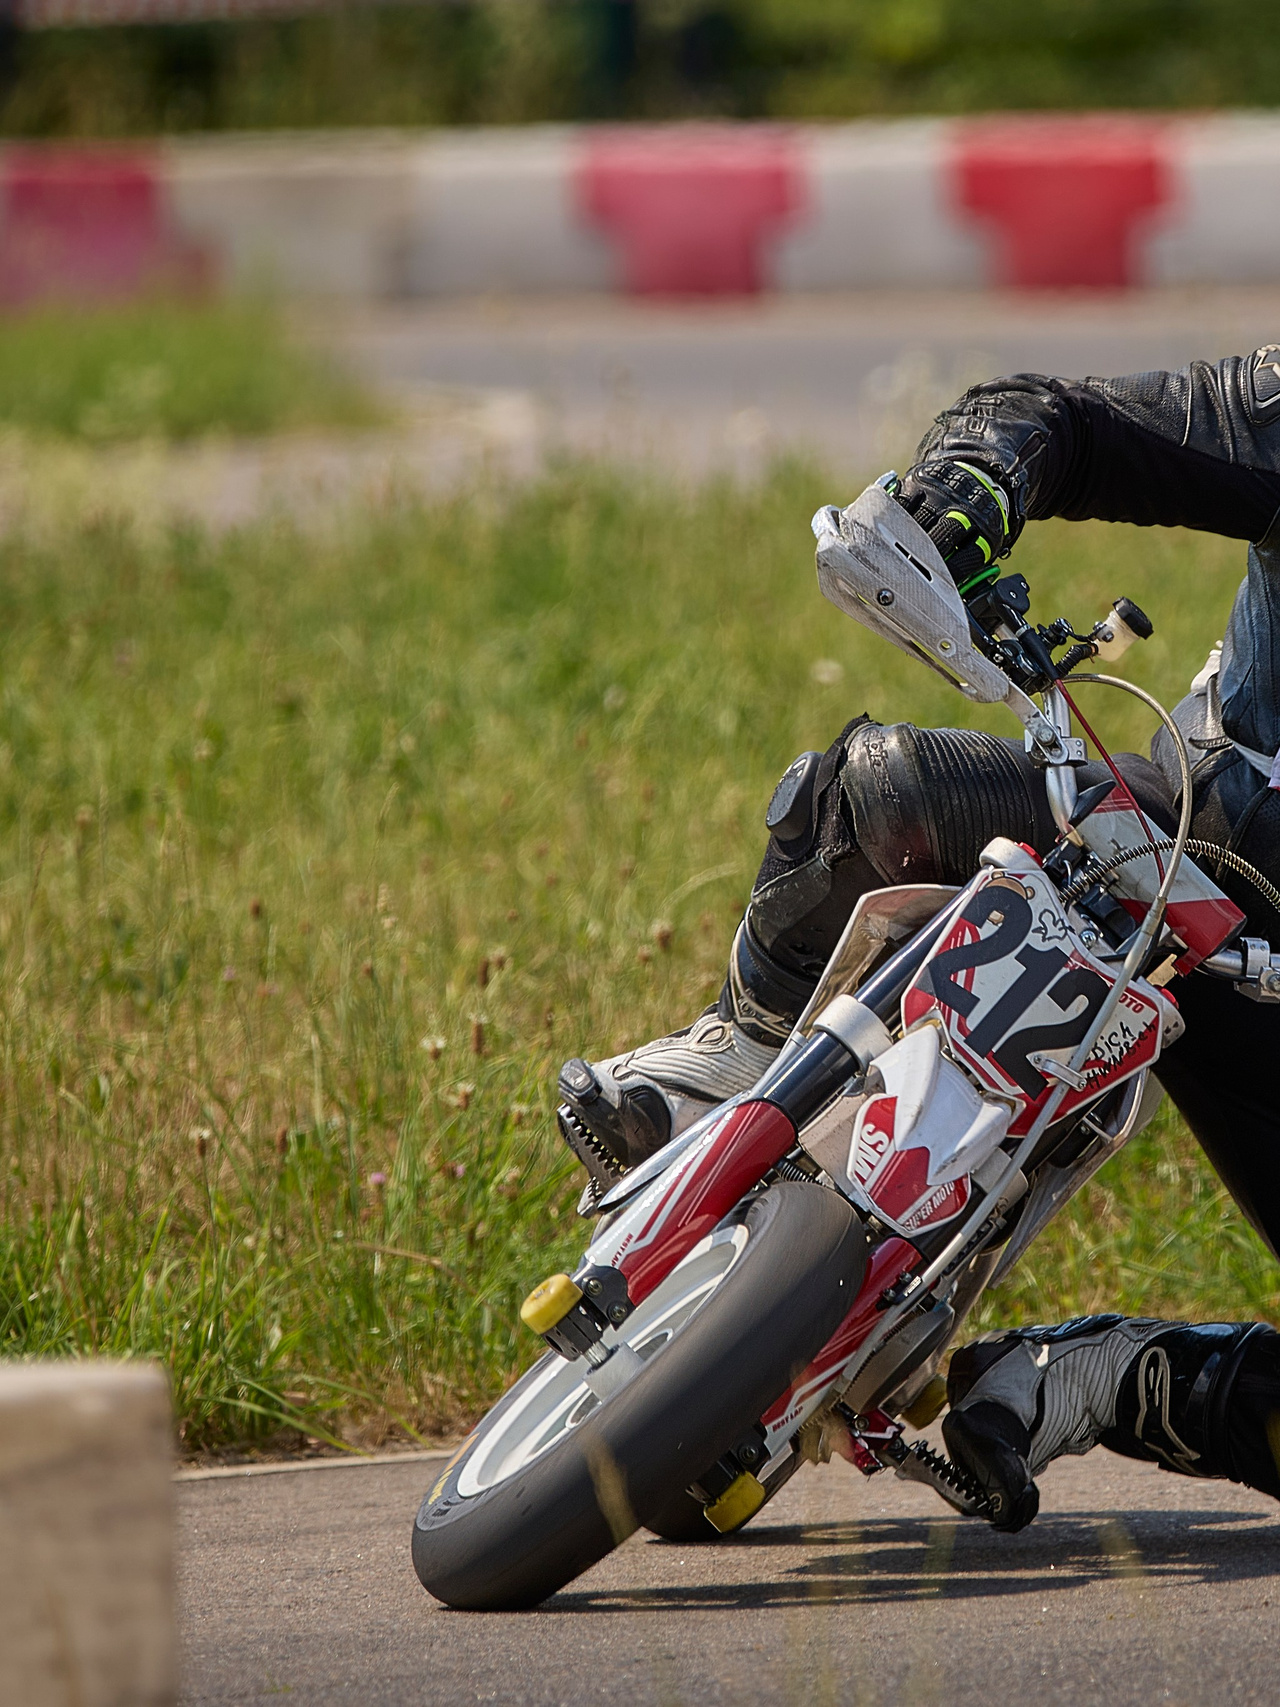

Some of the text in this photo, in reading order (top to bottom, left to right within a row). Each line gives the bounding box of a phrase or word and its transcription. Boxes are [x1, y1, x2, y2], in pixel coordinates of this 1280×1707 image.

[928, 884, 1110, 1101] 212
[1118, 993, 1145, 1014] OTO
[904, 1181, 955, 1230] SUPER MOTO
